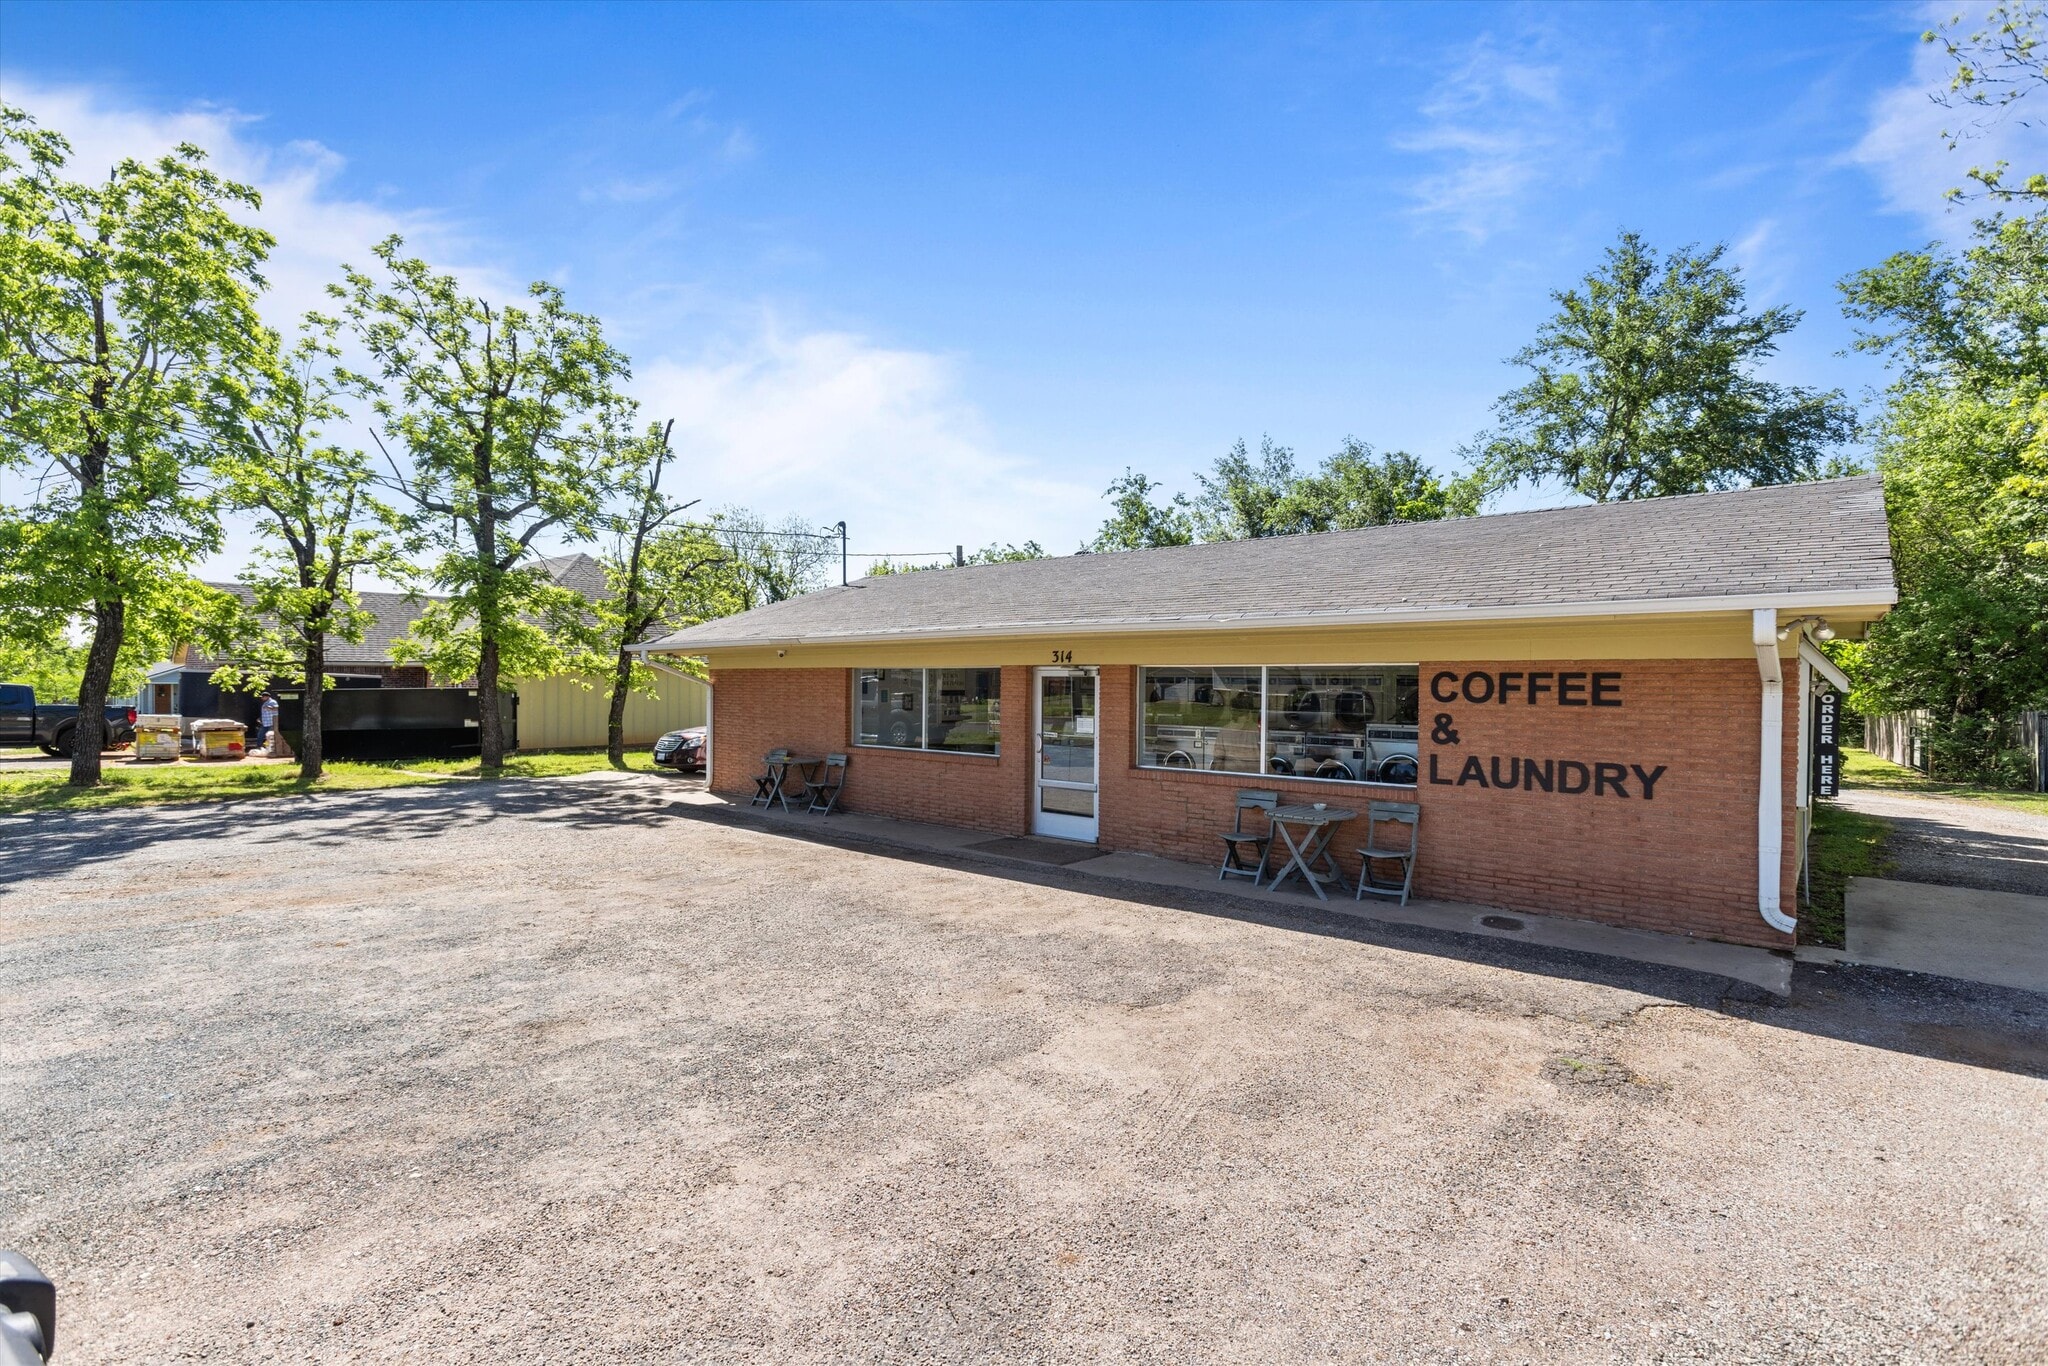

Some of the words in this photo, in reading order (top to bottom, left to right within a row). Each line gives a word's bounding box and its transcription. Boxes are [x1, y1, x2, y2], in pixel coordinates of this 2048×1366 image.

[1052, 650, 1072, 663] 314
[1430, 671, 1622, 706] COFFEE
[1431, 713, 1460, 745] &
[1821, 694, 1835, 744] ORDER
[1430, 754, 1668, 799] LAUNDRY
[1820, 755, 1833, 795] HERE
